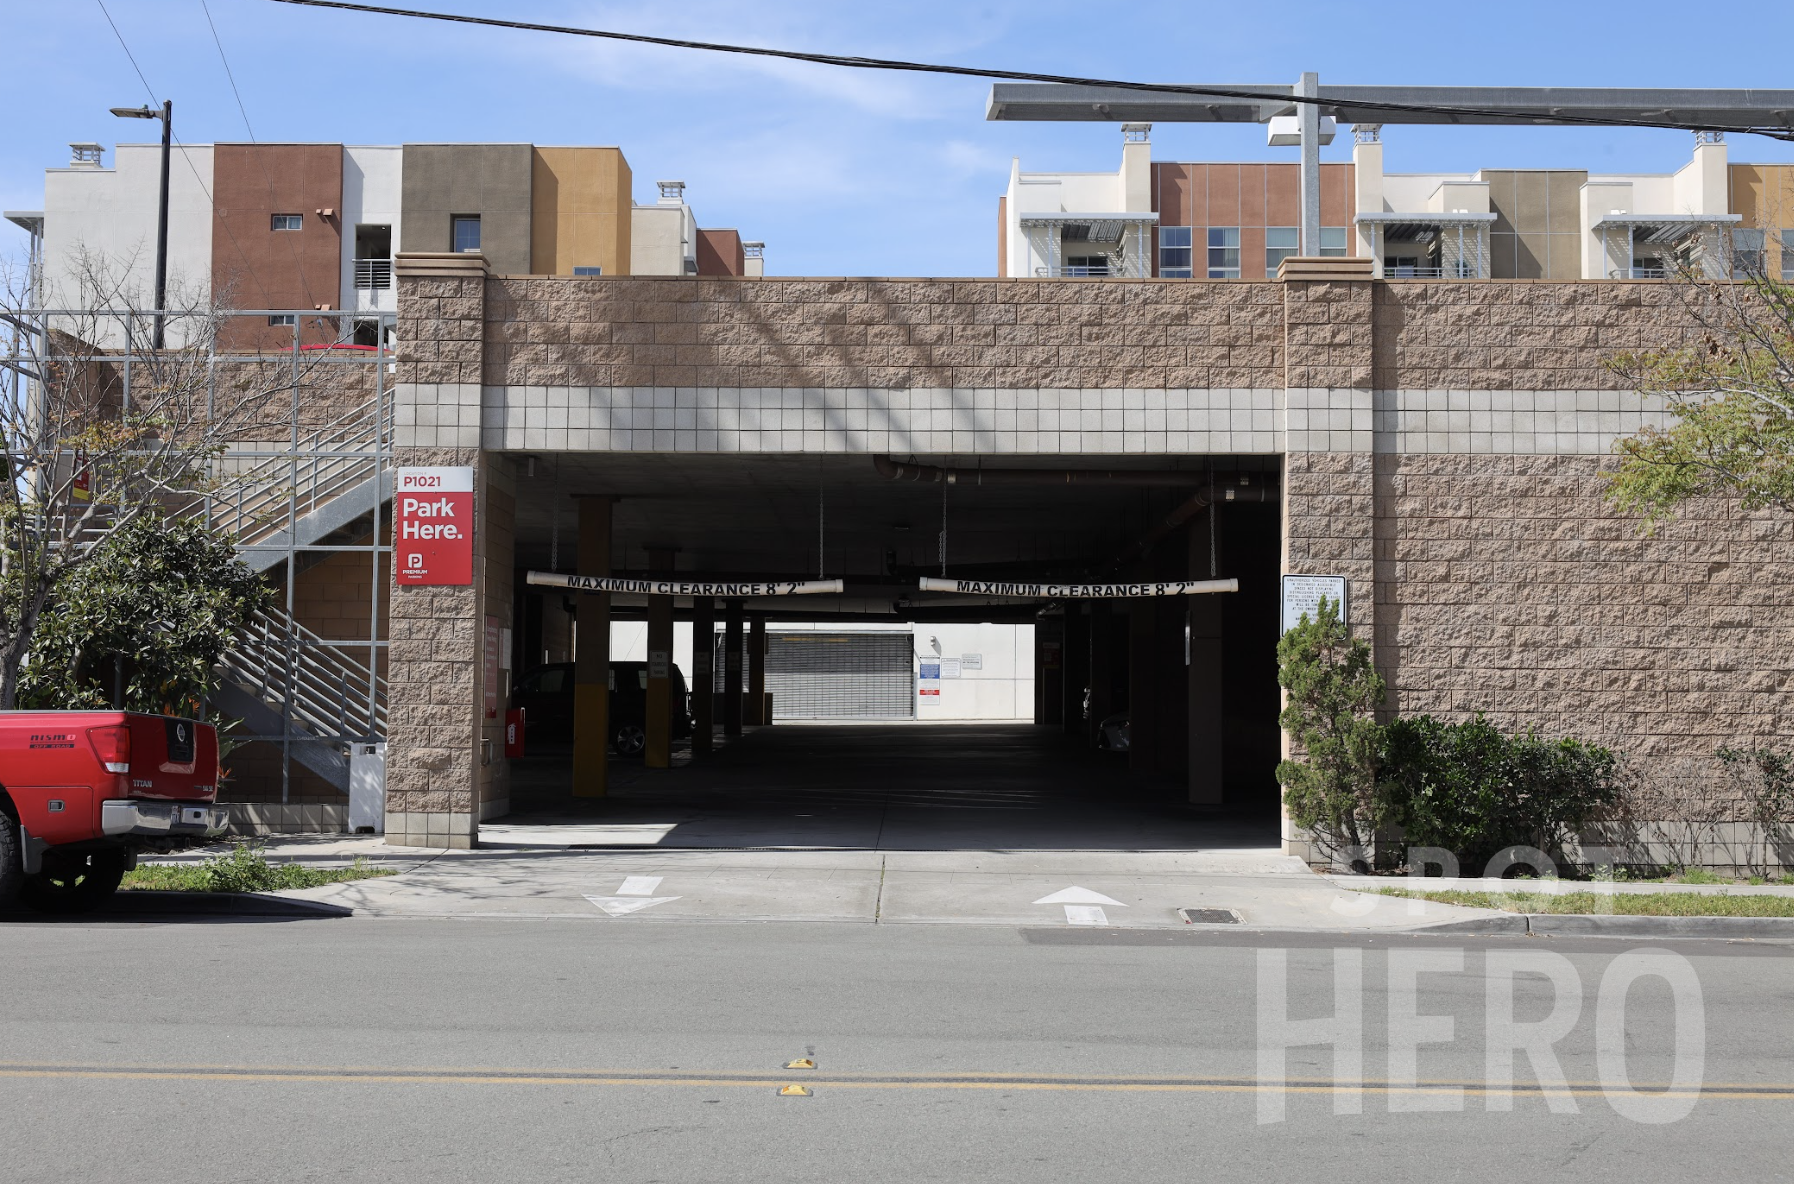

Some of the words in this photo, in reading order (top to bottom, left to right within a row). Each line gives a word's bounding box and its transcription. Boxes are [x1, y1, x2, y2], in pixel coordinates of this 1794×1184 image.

[404, 476, 441, 487] P1021
[403, 498, 455, 517] Park
[402, 520, 463, 539] Here.
[567, 576, 652, 593] MAXIMUM
[657, 583, 760, 595] CLEARANCE
[766, 582, 780, 595] 8'
[787, 582, 805, 594] 2"
[956, 580, 1040, 596] MAXIMUM
[1047, 585, 1150, 597] CLEARANCE
[1155, 584, 1169, 596] 8'
[1176, 582, 1194, 595] 2"
[133, 780, 153, 788] TITAN
